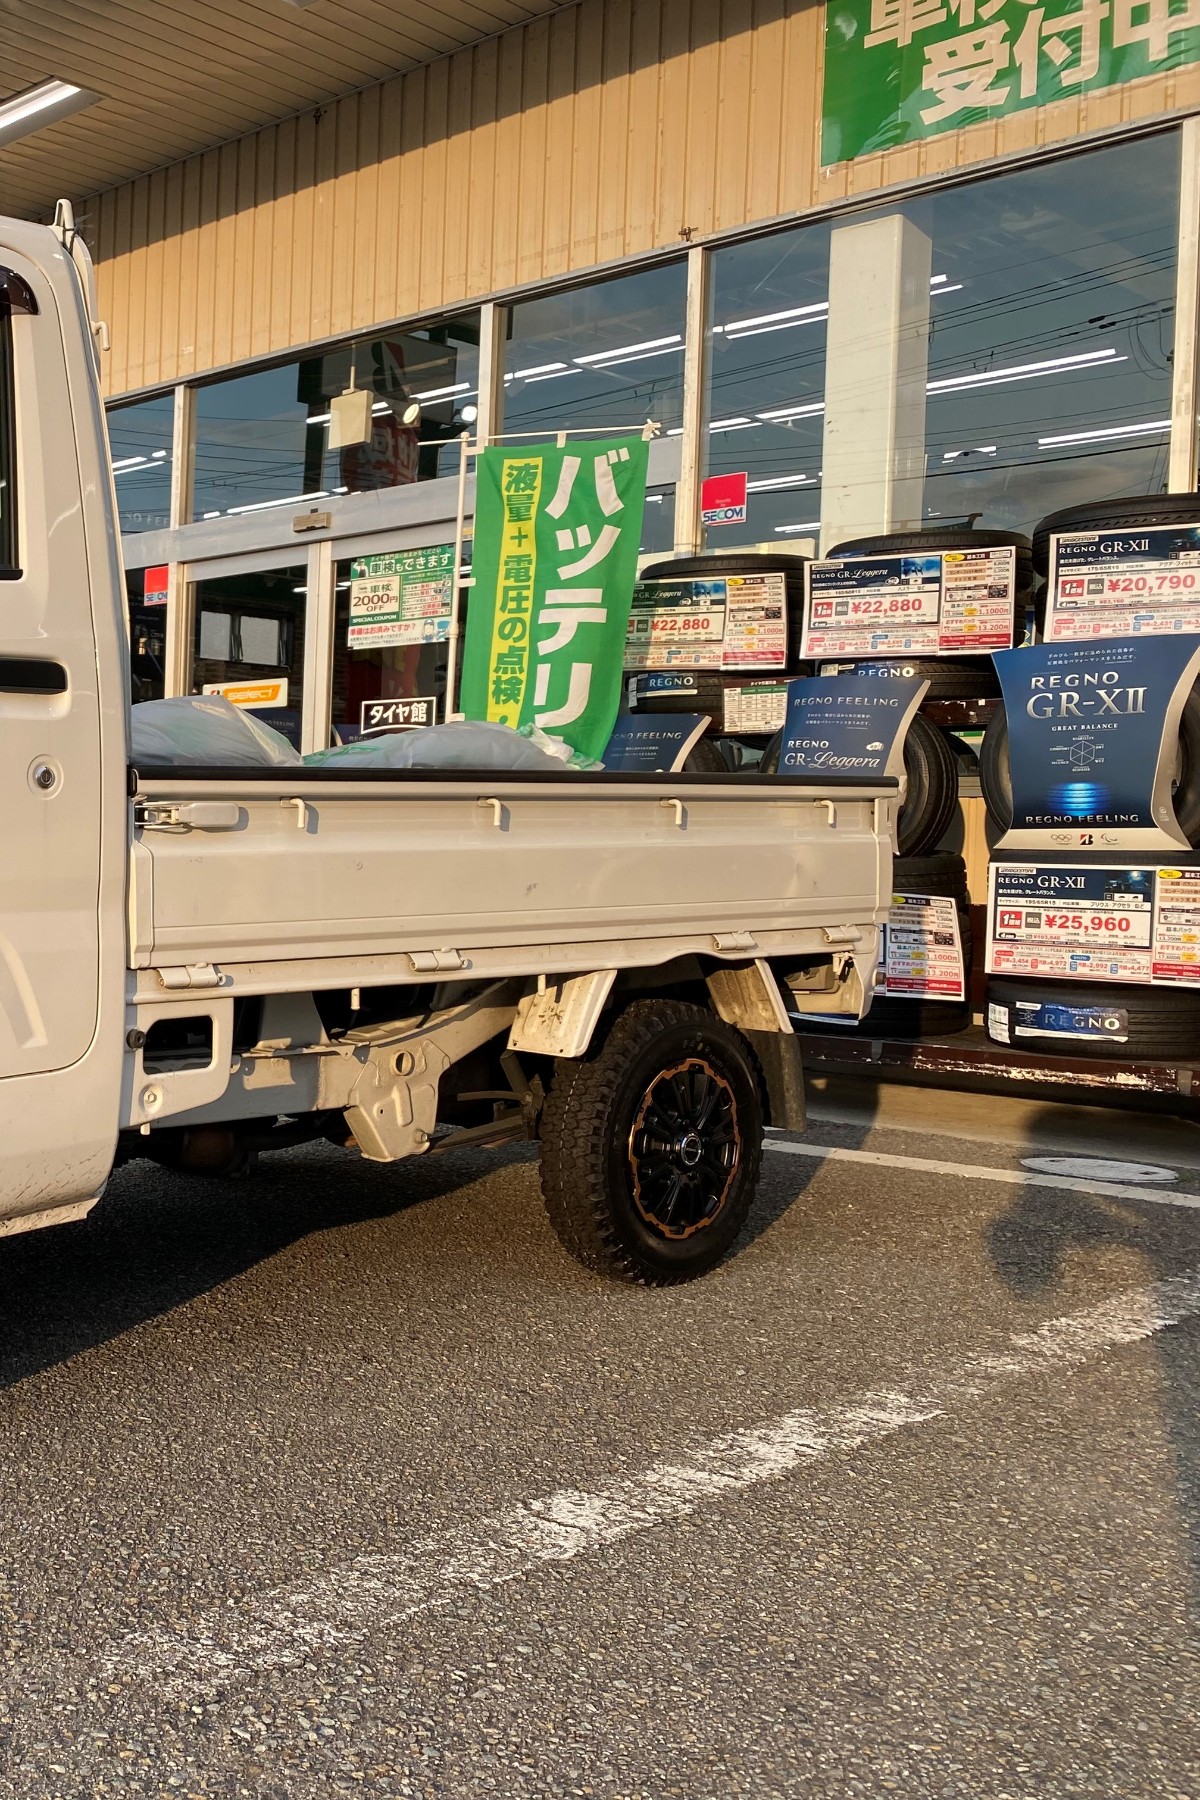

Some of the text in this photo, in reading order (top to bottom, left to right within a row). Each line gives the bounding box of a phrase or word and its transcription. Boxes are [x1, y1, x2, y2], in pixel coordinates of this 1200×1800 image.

[703, 507, 743, 522] SECOM
[1059, 545, 1096, 554] REGNO
[370, 553, 451, 576] 車検もできます
[1107, 574, 1196, 593] ¥20,790
[353, 593, 398, 607] 2000円
[534, 447, 630, 743] バッテリ
[851, 598, 923, 615] ¥22,880
[651, 618, 710, 632] ¥22,880
[650, 676, 694, 687] REGNO
[1030, 671, 1119, 690] REGNO
[227, 687, 274, 701] select
[794, 697, 899, 707] REGNO FEELING
[369, 702, 428, 724] タイヤ館
[636, 732, 682, 740] FEELING
[787, 740, 829, 749] REGNO
[784, 751, 881, 770] GR-Leggera
[1025, 814, 1139, 824] REGNO FEELING
[998, 877, 1034, 885] REGNO
[1044, 914, 1131, 933] ¥25,960
[1044, 1013, 1120, 1031] REGNO
